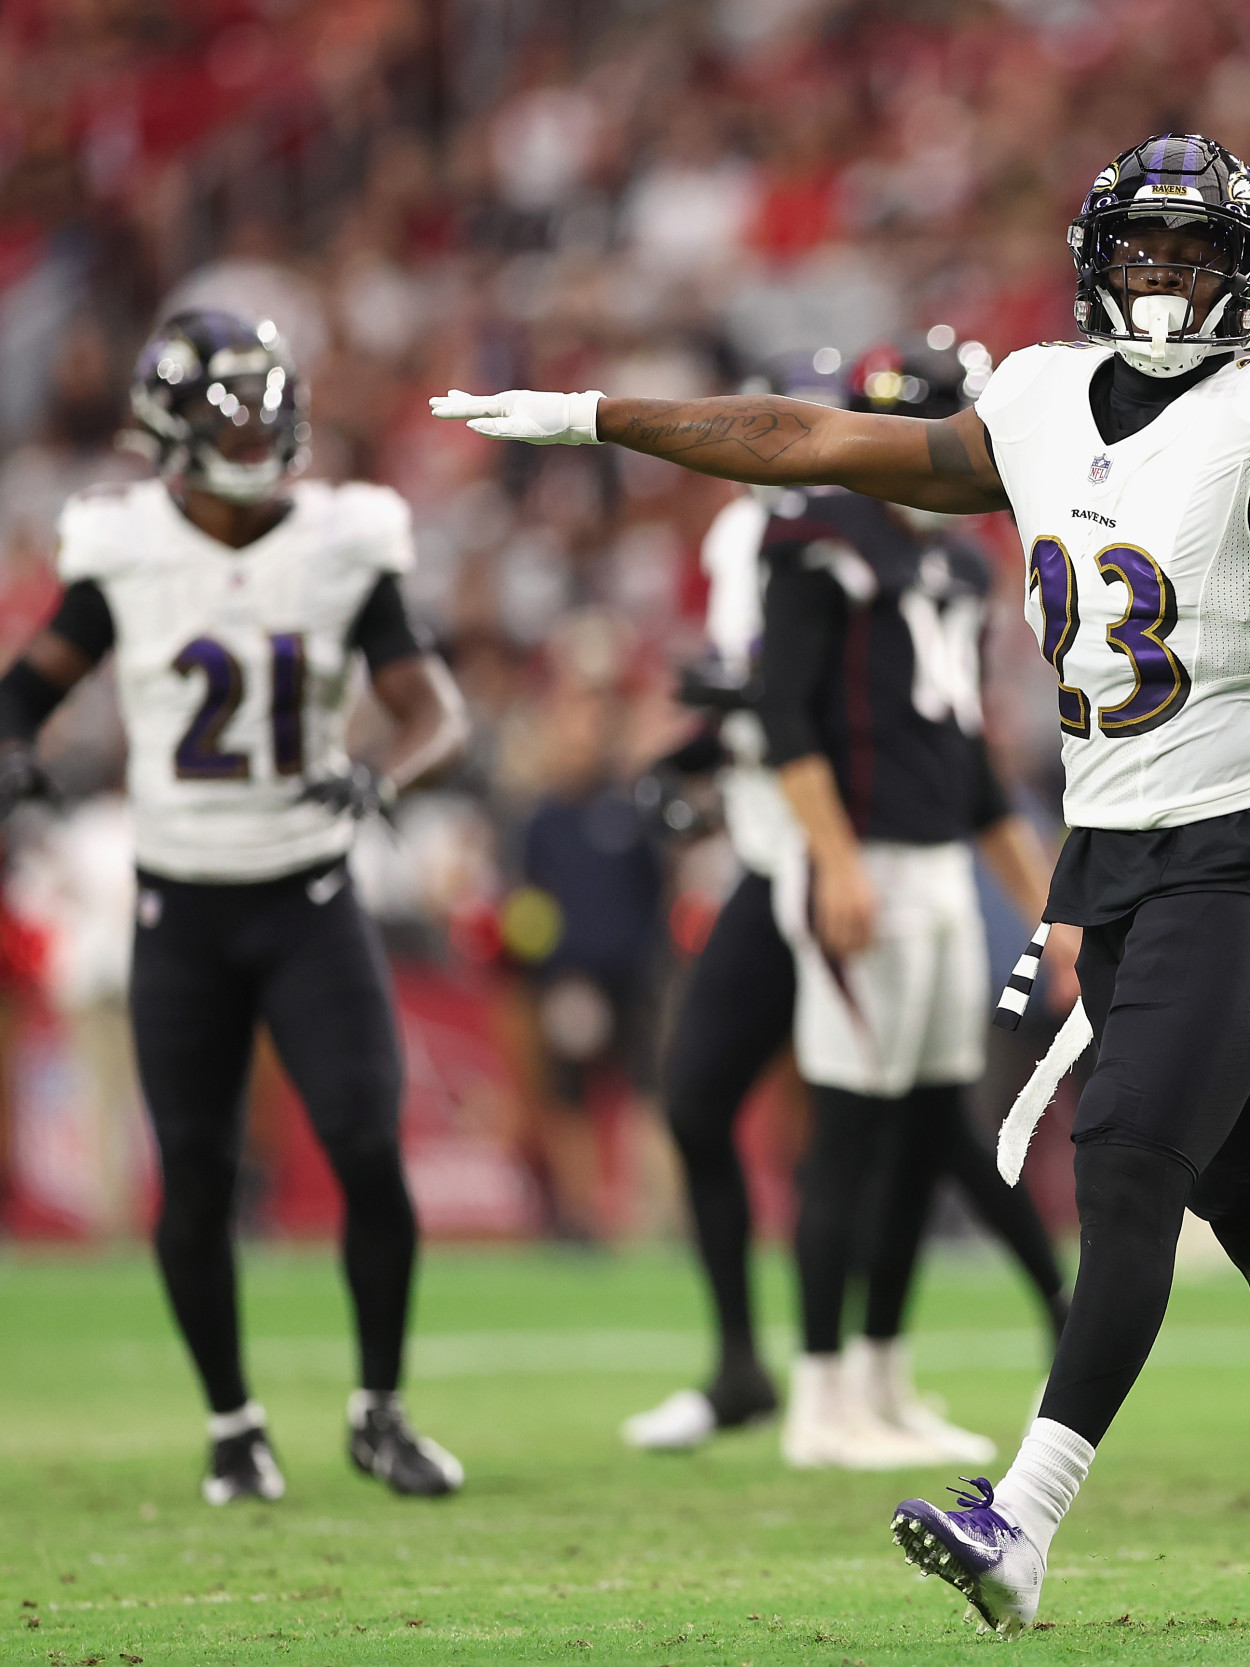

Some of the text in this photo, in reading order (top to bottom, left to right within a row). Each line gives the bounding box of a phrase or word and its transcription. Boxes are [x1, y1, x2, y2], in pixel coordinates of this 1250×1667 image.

[1151, 185, 1188, 196] RAVENS
[1089, 467, 1106, 480] NFL
[1071, 509, 1117, 528] RAVENS
[1029, 534, 1191, 740] 23
[170, 632, 307, 780] 21
